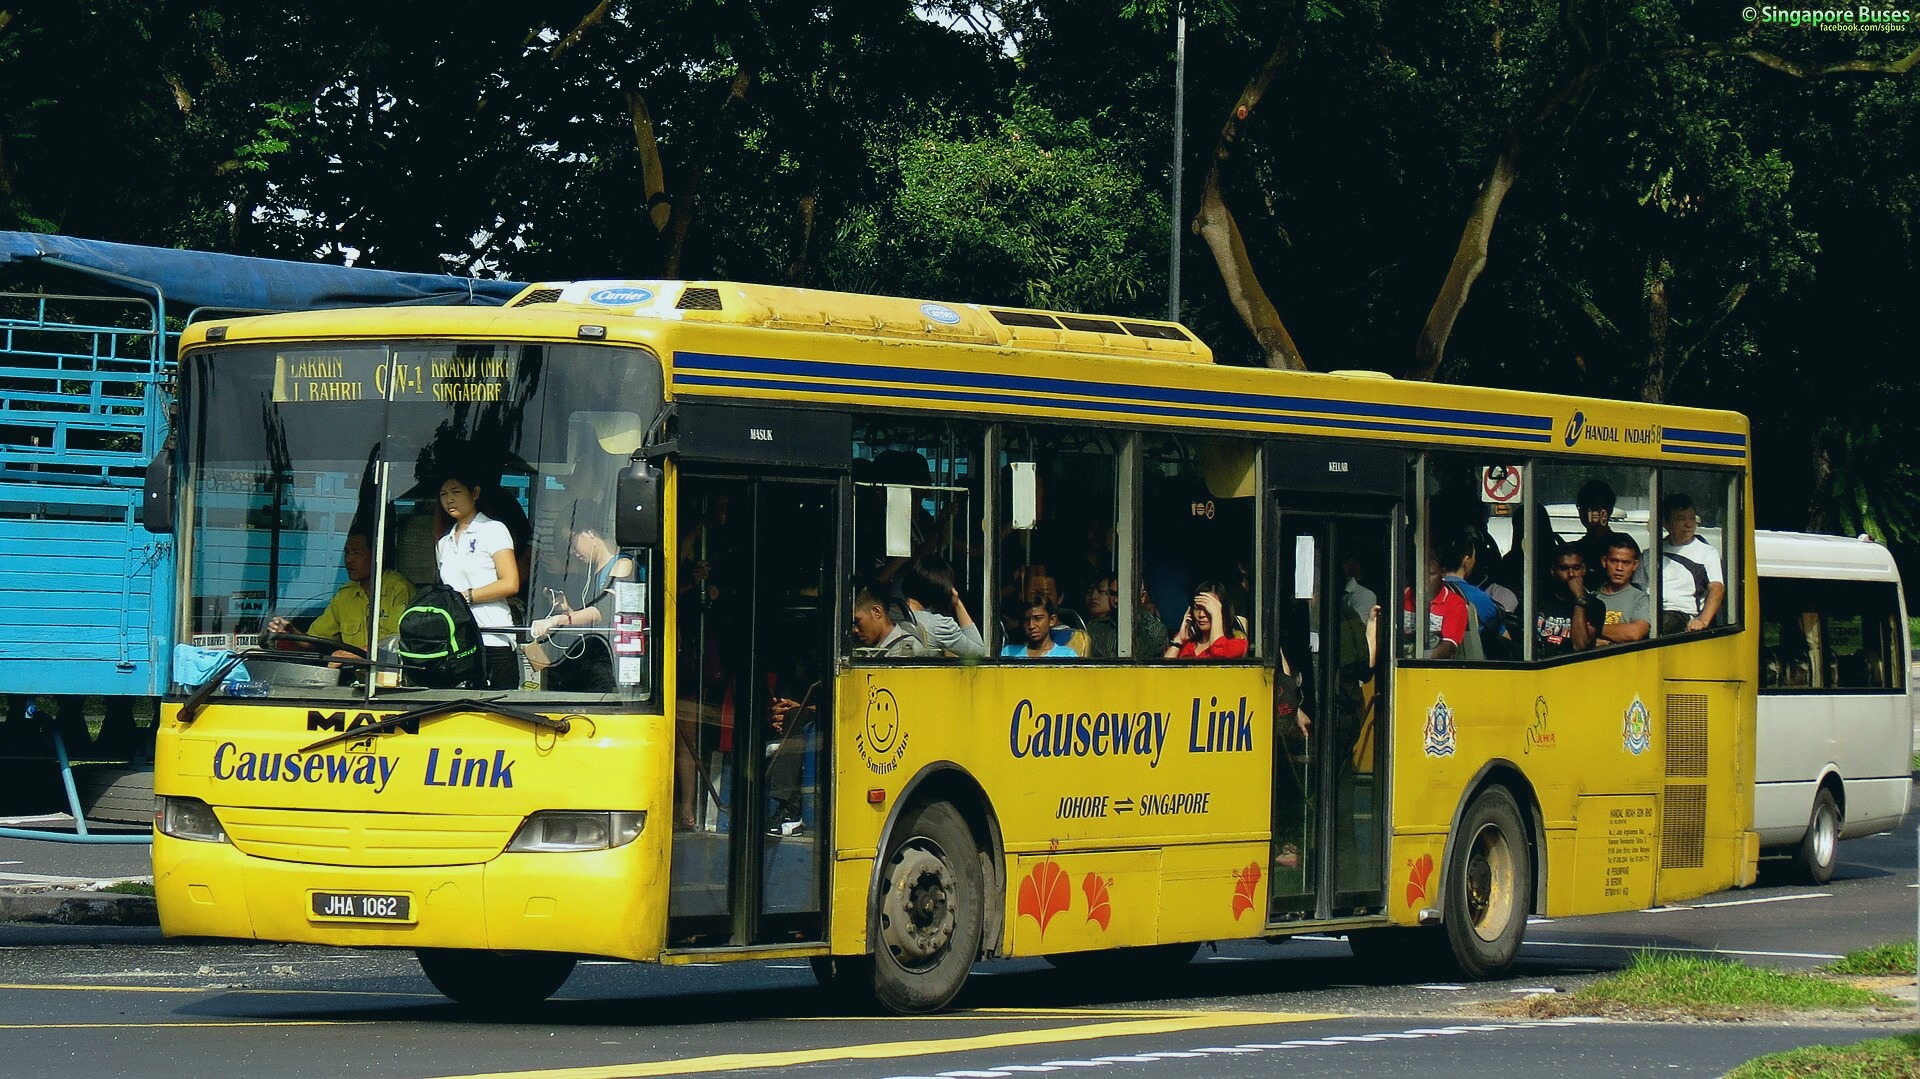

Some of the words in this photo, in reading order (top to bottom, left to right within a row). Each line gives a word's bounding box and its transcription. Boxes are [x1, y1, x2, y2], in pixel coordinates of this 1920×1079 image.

[597, 290, 646, 301] Carrier
[431, 357, 477, 378] KRANJI
[432, 383, 502, 402] SINGAPORE
[750, 428, 773, 441] MASUK
[1585, 424, 1620, 442] HANDAL
[1624, 427, 1650, 444] INDAH
[206, 636, 226, 646] DRIVER
[307, 710, 420, 735] MAN
[1010, 698, 1171, 768] Causeway
[1188, 696, 1254, 753] Link
[855, 731, 867, 760] The
[866, 756, 898, 775] Smiling
[895, 731, 909, 760] Bus
[213, 741, 400, 794] Causeway
[423, 747, 517, 789] Link
[1056, 796, 1109, 819] JOHORE
[1139, 792, 1210, 816] SINGAPORE
[324, 895, 355, 916] JHA
[361, 896, 398, 917] 1062
